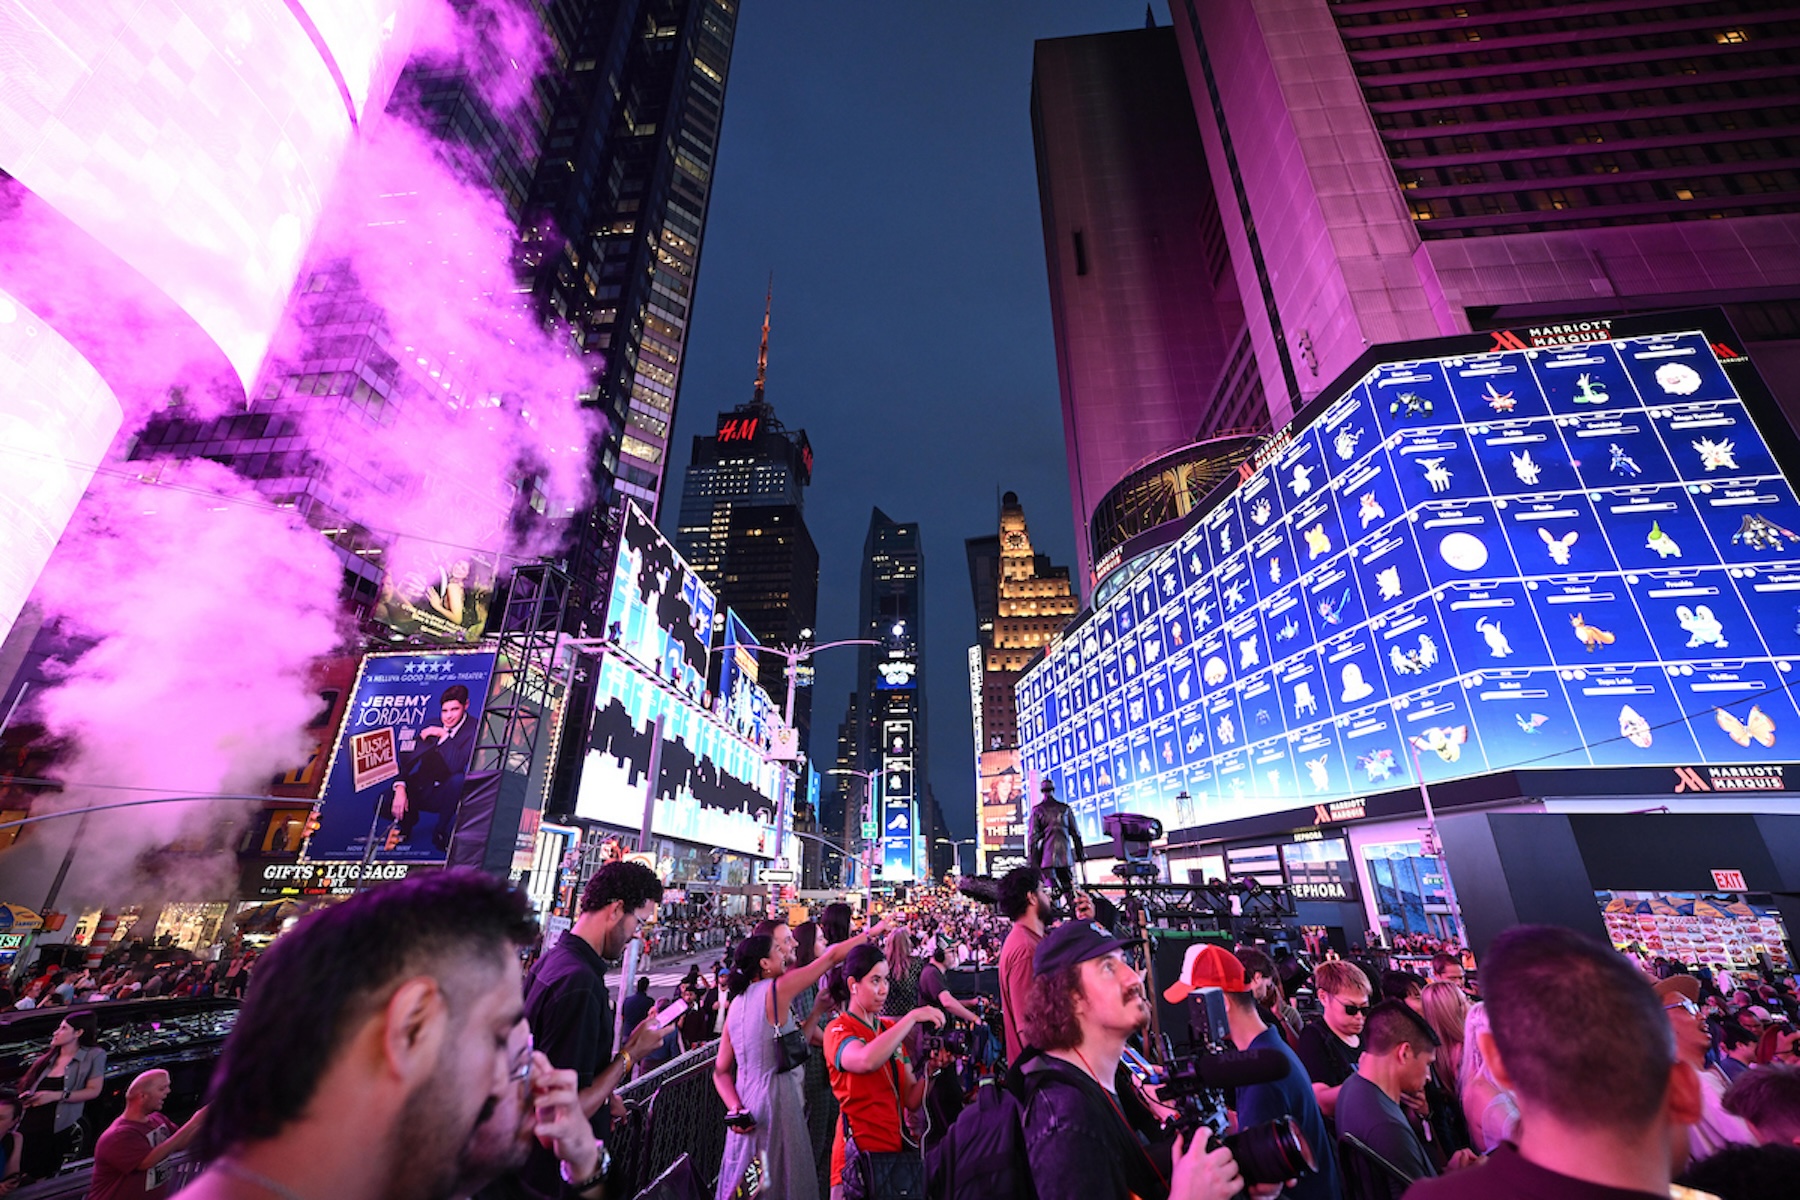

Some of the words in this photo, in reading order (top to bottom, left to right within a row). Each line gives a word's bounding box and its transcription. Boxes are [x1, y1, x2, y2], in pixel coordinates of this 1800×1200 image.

[1529, 320, 1612, 336] MARRIOTT
[1533, 331, 1609, 347] MARQUIS
[717, 418, 758, 442] H&M
[1253, 421, 1293, 461] MARRIOTT
[1255, 435, 1291, 470] MARQUIS
[401, 674, 422, 682] GOOD
[362, 694, 432, 708] JEREMY
[355, 707, 427, 726] JORDAN
[358, 736, 384, 756] JUST
[358, 747, 393, 769] TIME
[1709, 766, 1783, 777] MARRIOTT
[1715, 778, 1780, 789] MARQUIS
[1330, 798, 1366, 811] MARRIOTT
[1332, 808, 1364, 820] MARQUIS
[986, 826, 1008, 836] THE
[1008, 824, 1028, 836] HE
[1293, 831, 1323, 842] SEPHORA
[263, 865, 315, 880] GIFTS
[325, 865, 408, 880] LUGGAGE
[1714, 872, 1743, 889] EXIT
[331, 887, 356, 895] SONY
[1291, 883, 1346, 898] SEPHORA
